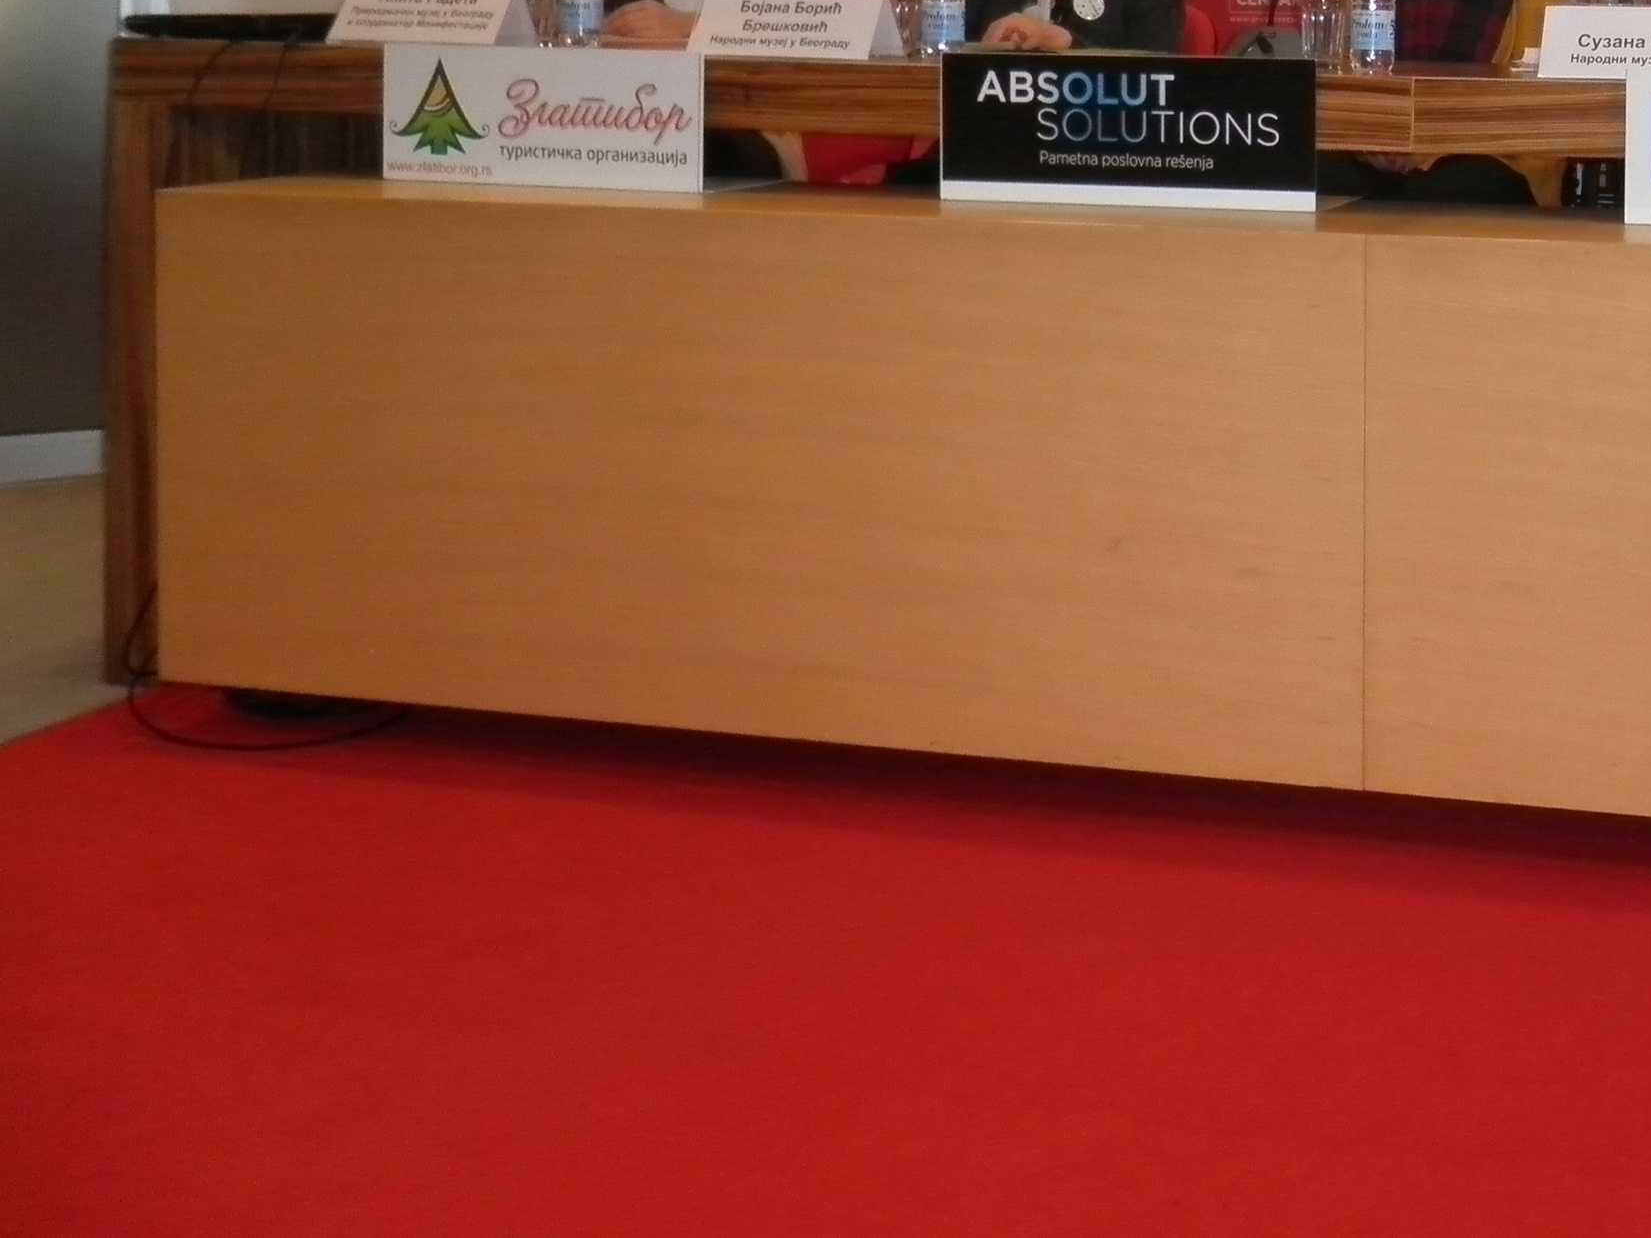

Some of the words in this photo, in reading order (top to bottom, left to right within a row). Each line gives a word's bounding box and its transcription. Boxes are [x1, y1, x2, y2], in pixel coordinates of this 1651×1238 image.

[740, 0, 790, 16] Бојана
[794, 1, 842, 16] Борић
[742, 19, 828, 33] Брешковић
[710, 35, 756, 44] Народни
[759, 37, 788, 48] музеј
[790, 40, 796, 48] у
[799, 38, 850, 49] Београду
[1578, 32, 1646, 51] Сузана
[1570, 53, 1627, 67] Народни
[977, 70, 1175, 106] ABSOLUT
[1036, 108, 1280, 147] SOLUTIONS
[499, 144, 582, 160] туристичка
[586, 148, 688, 167] организација
[1039, 149, 1098, 166] Pametna
[1101, 152, 1162, 169] poslovna
[1165, 153, 1214, 170] rešenja
